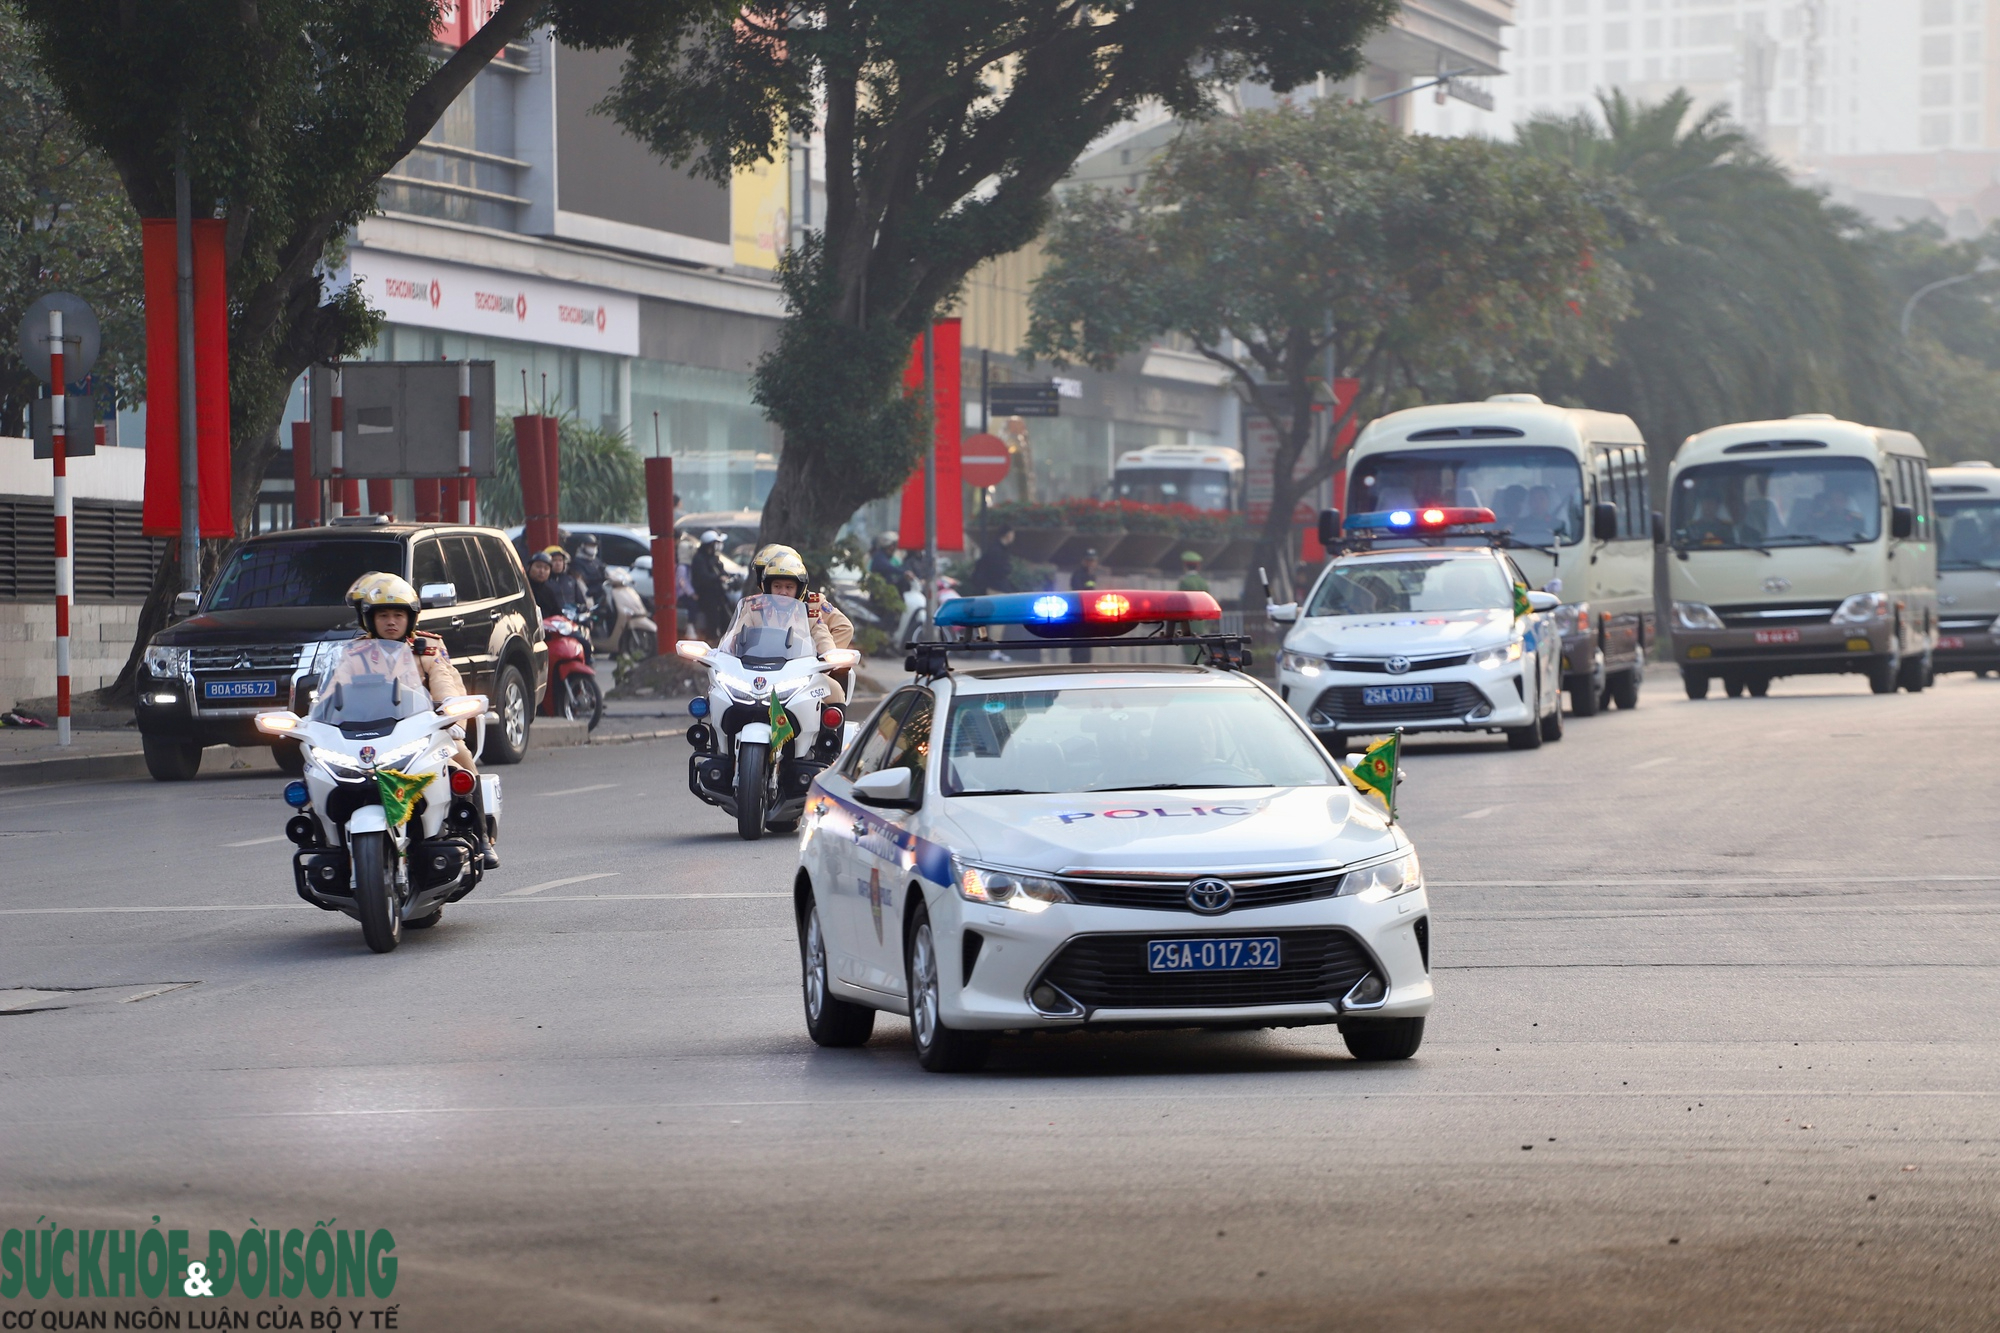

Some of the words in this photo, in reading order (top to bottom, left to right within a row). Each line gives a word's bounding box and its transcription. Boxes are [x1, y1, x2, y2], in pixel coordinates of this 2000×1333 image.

[386, 278, 428, 301] TECHCOMBANK
[475, 291, 515, 313] TECHCOMBANK
[558, 304, 595, 326] TECHCOMBANK
[211, 683, 270, 695] 80A-056.72
[1058, 806, 1253, 824] POLIC
[1152, 941, 1276, 968] 29A-017.32
